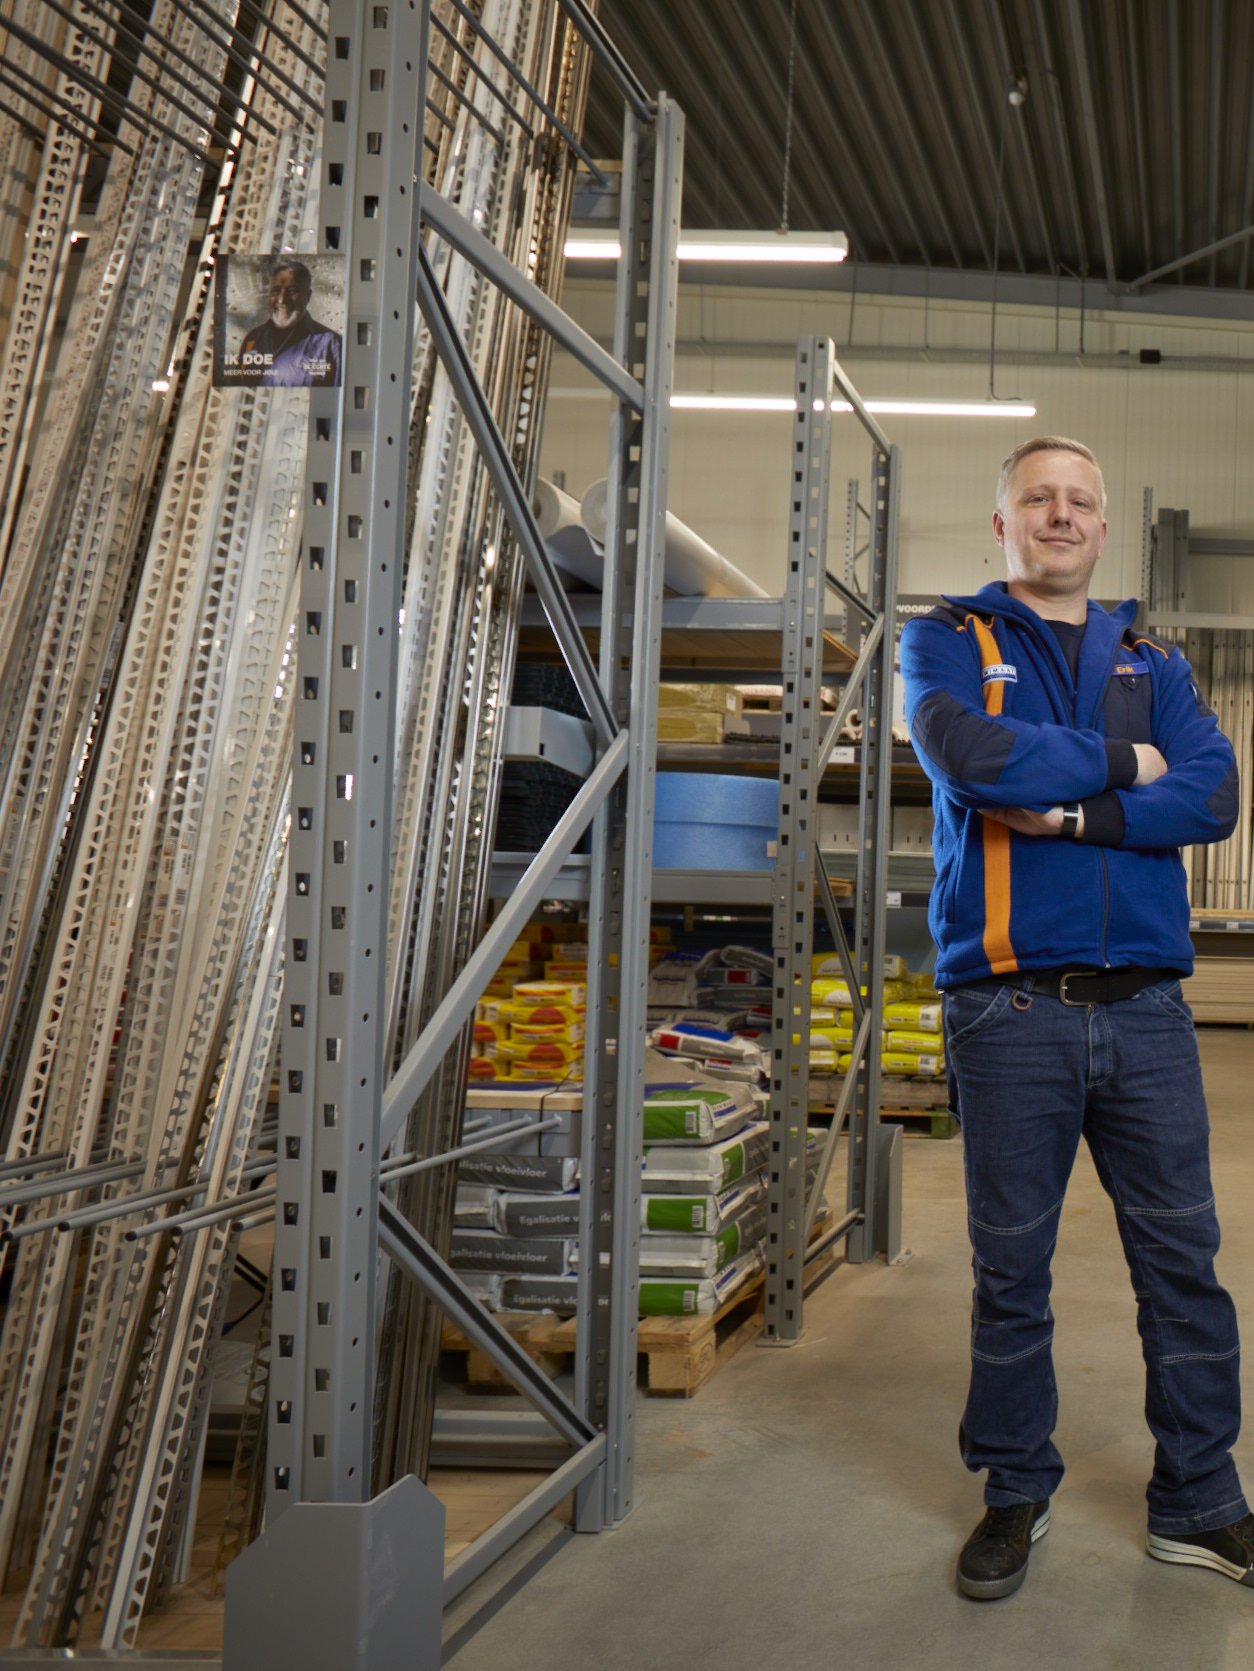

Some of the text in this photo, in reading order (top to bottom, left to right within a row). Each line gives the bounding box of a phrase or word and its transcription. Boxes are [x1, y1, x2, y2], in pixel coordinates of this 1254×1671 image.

[224, 354, 274, 366] IK DOE
[495, 1165, 548, 1178] vloeivloer
[519, 1214, 571, 1226] Egalisatie
[450, 1248, 549, 1262] galisatie vloeivloer
[513, 1294, 562, 1306] Egalisatie
